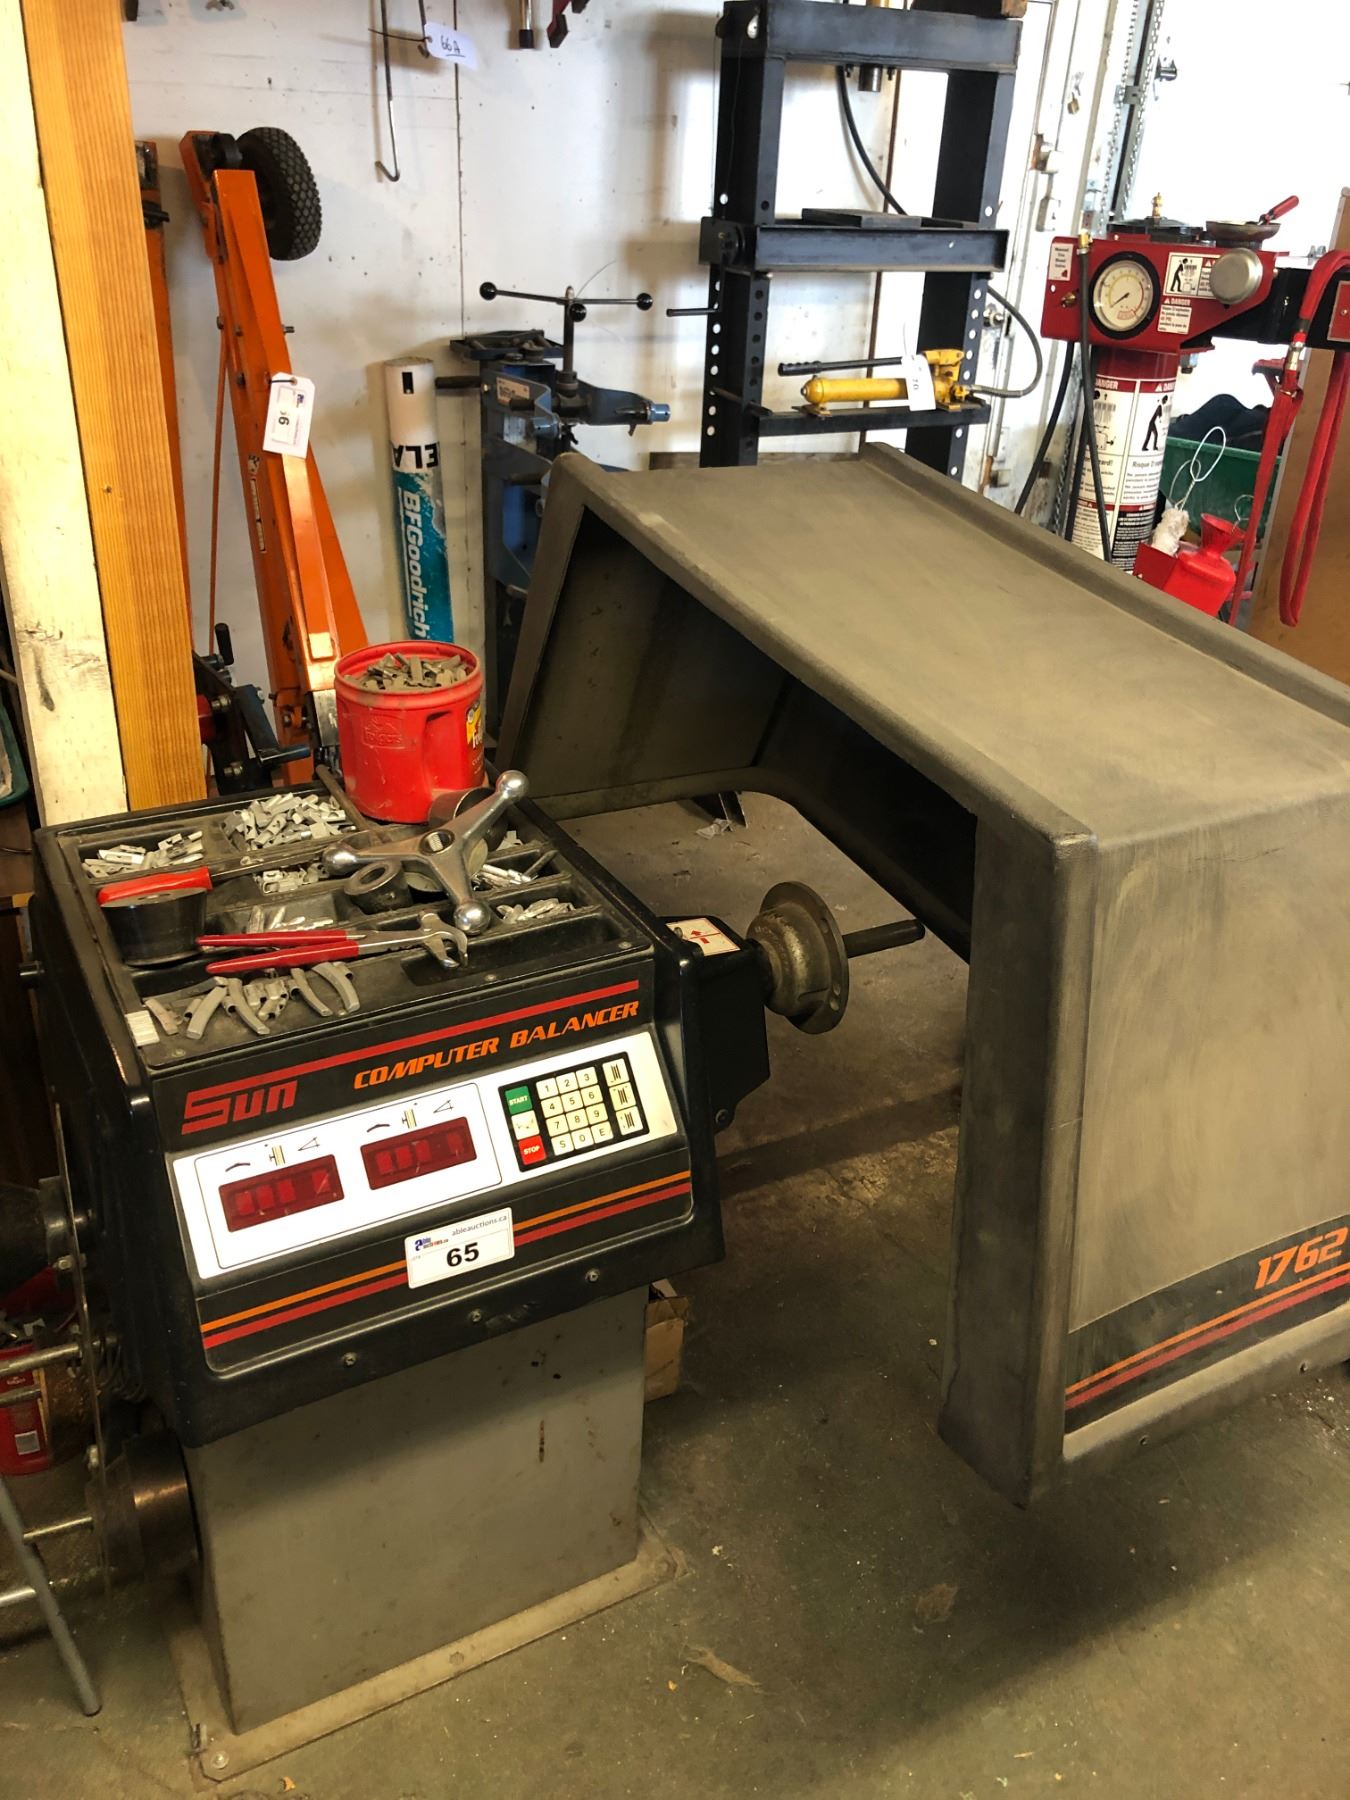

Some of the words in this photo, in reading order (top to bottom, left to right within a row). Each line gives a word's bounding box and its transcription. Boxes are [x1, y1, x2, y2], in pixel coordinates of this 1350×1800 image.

[402, 490, 430, 639] BFGoodrich
[353, 1037, 499, 1090] COMPUTER
[508, 1000, 640, 1048] BALANCER
[545, 1085, 550, 1093] 1
[564, 1079, 570, 1088] 2
[584, 1073, 590, 1082] 3
[509, 1095, 528, 1106] START
[549, 1103, 556, 1111] 4
[569, 1098, 575, 1106] 5
[588, 1092, 595, 1100] 6
[554, 1121, 560, 1129] 7
[574, 1115, 581, 1123] 8
[593, 1109, 600, 1118] 9
[599, 1128, 606, 1137] E
[523, 1145, 541, 1155] STOP
[451, 1215, 507, 1237] ableauctions.ca
[446, 1241, 480, 1267] 65
[1255, 1227, 1348, 1290] 1762
